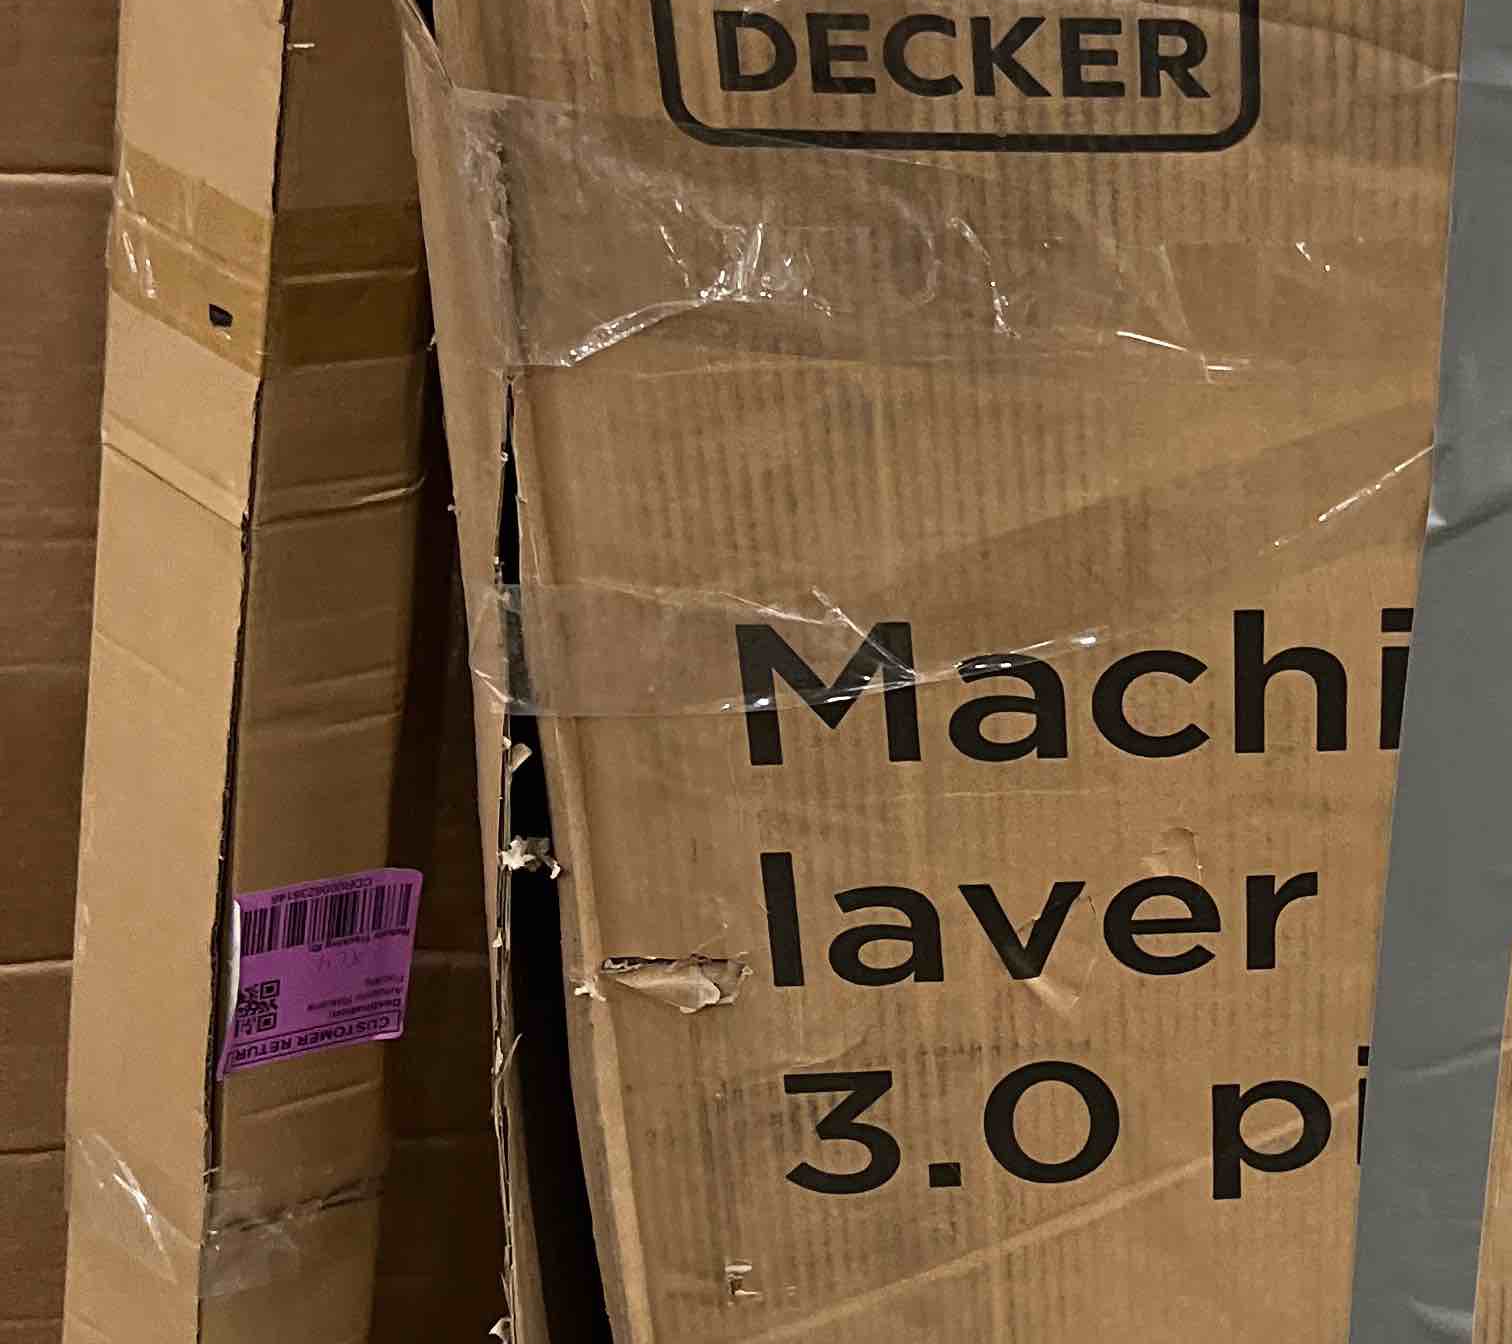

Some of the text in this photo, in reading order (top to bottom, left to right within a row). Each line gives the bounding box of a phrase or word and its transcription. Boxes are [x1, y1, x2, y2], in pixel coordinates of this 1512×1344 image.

[713, 11, 1211, 98] DECKER
[760, 851, 1319, 988] laver
[298, 1015, 390, 1043] CUSTOMER
[784, 1060, 1121, 1195] 3.0
